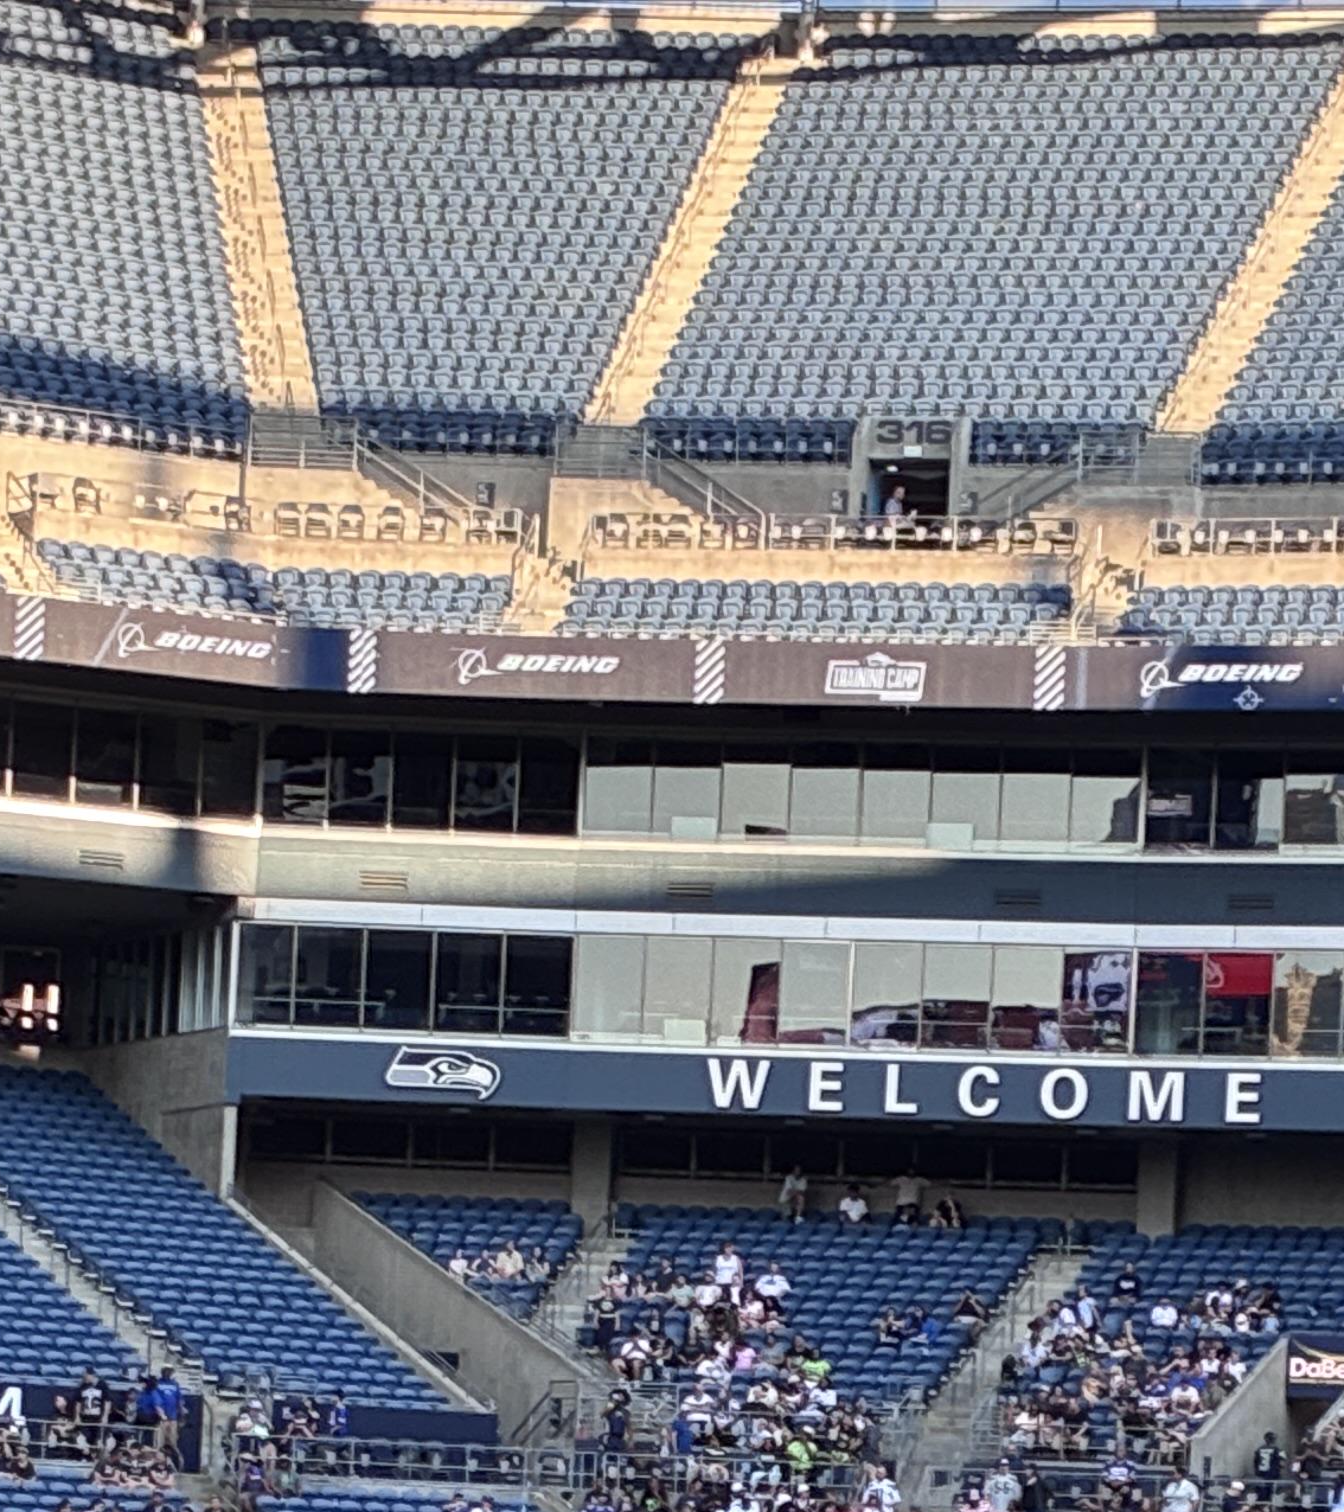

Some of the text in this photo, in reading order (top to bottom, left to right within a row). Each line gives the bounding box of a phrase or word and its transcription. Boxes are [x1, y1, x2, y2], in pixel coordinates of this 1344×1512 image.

[876, 420, 953, 445] 316
[153, 630, 273, 660] BOEING
[497, 654, 620, 674] BOEING
[1177, 661, 1304, 682] BOEING
[833, 667, 919, 690] TRAINING CAMP
[706, 1058, 1263, 1128] WELCOME
